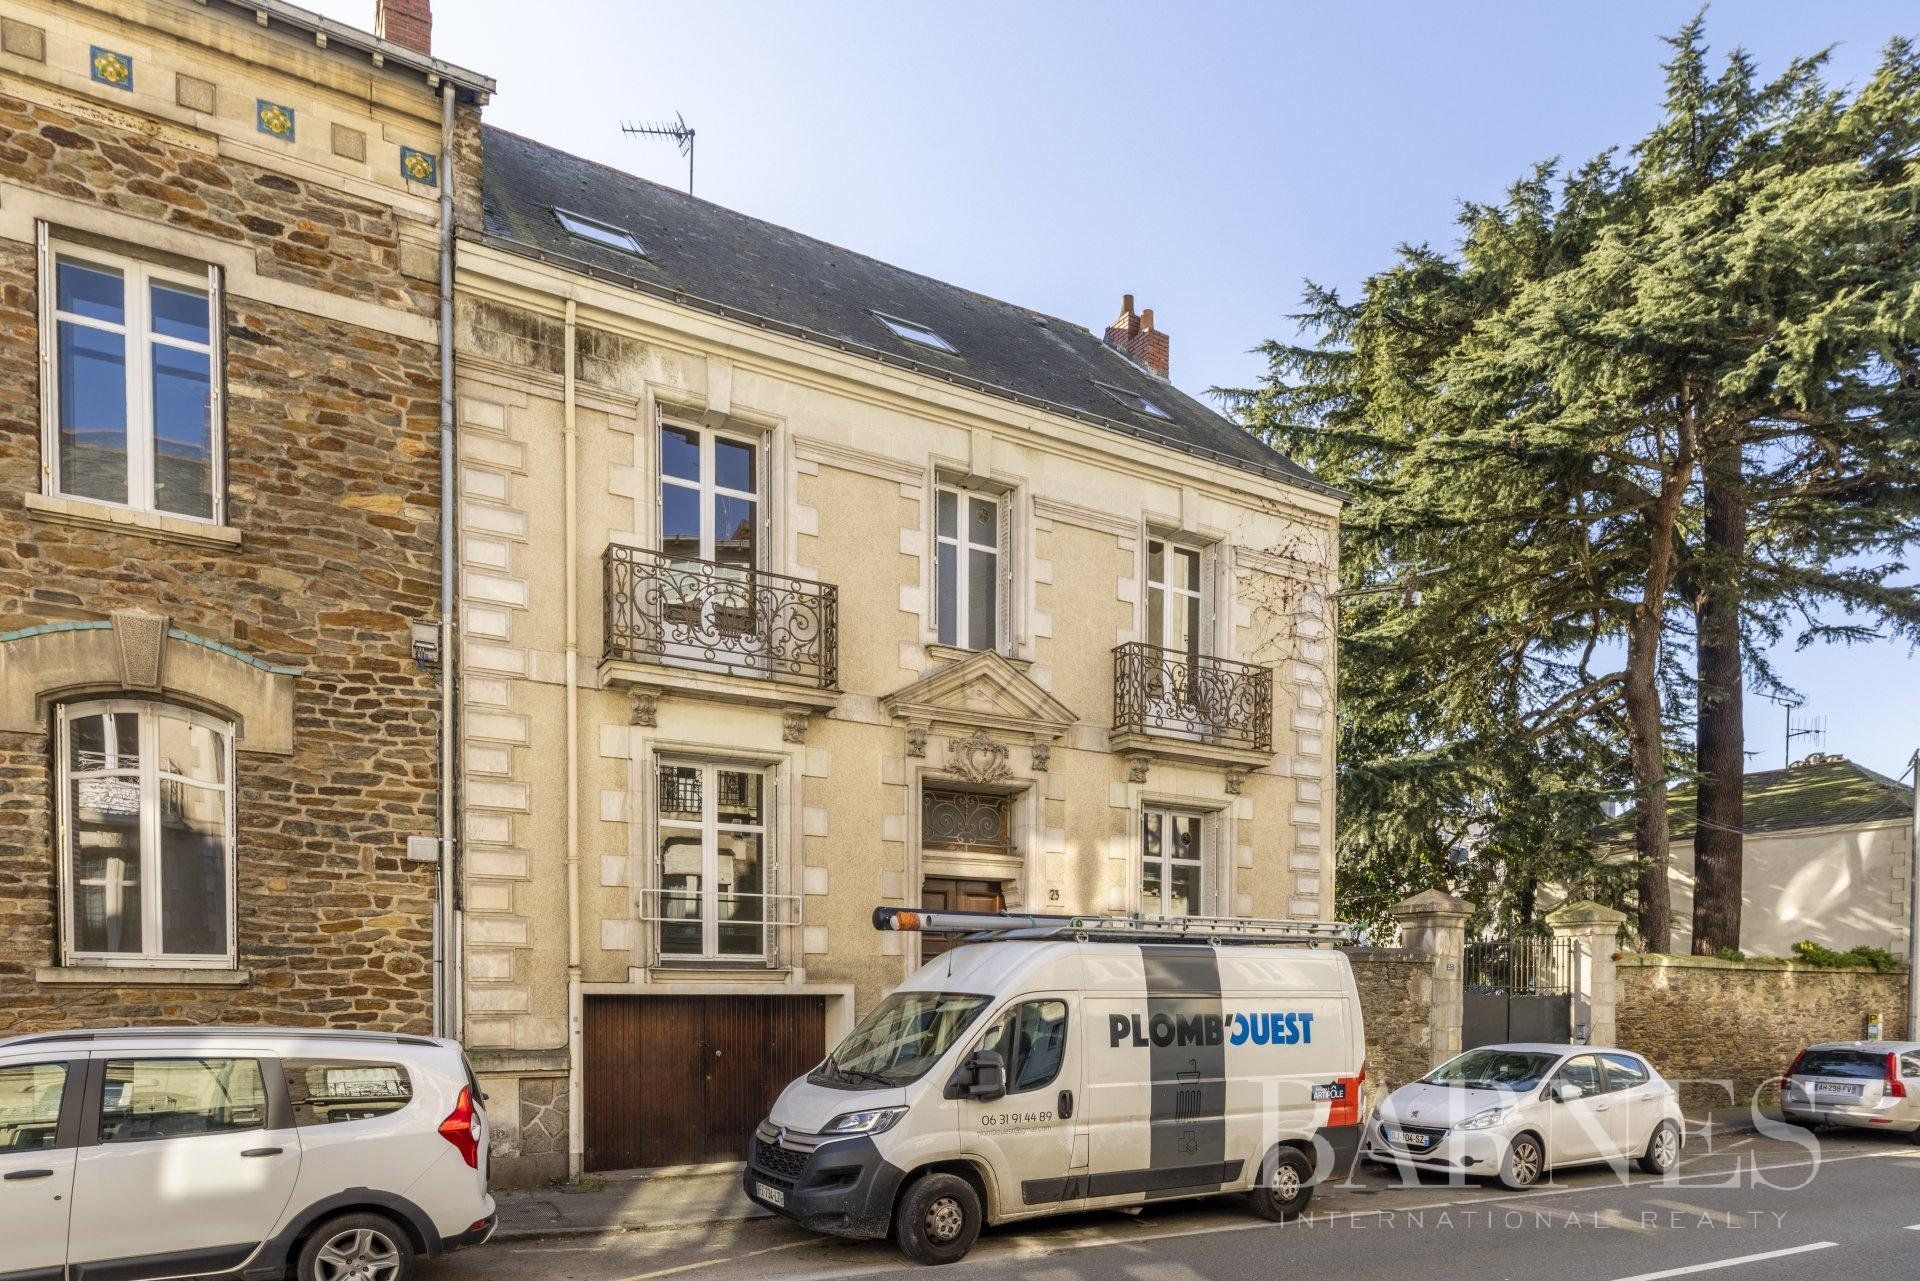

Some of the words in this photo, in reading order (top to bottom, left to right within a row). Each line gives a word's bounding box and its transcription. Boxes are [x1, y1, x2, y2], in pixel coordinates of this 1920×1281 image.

[1108, 1012, 1314, 1048] PLOMB'OUEST
[981, 1115, 996, 1126] 06
[999, 1114, 1009, 1125] 31
[1011, 1113, 1022, 1124] 91
[1024, 1112, 1037, 1122] 44
[1039, 1111, 1053, 1122] 89
